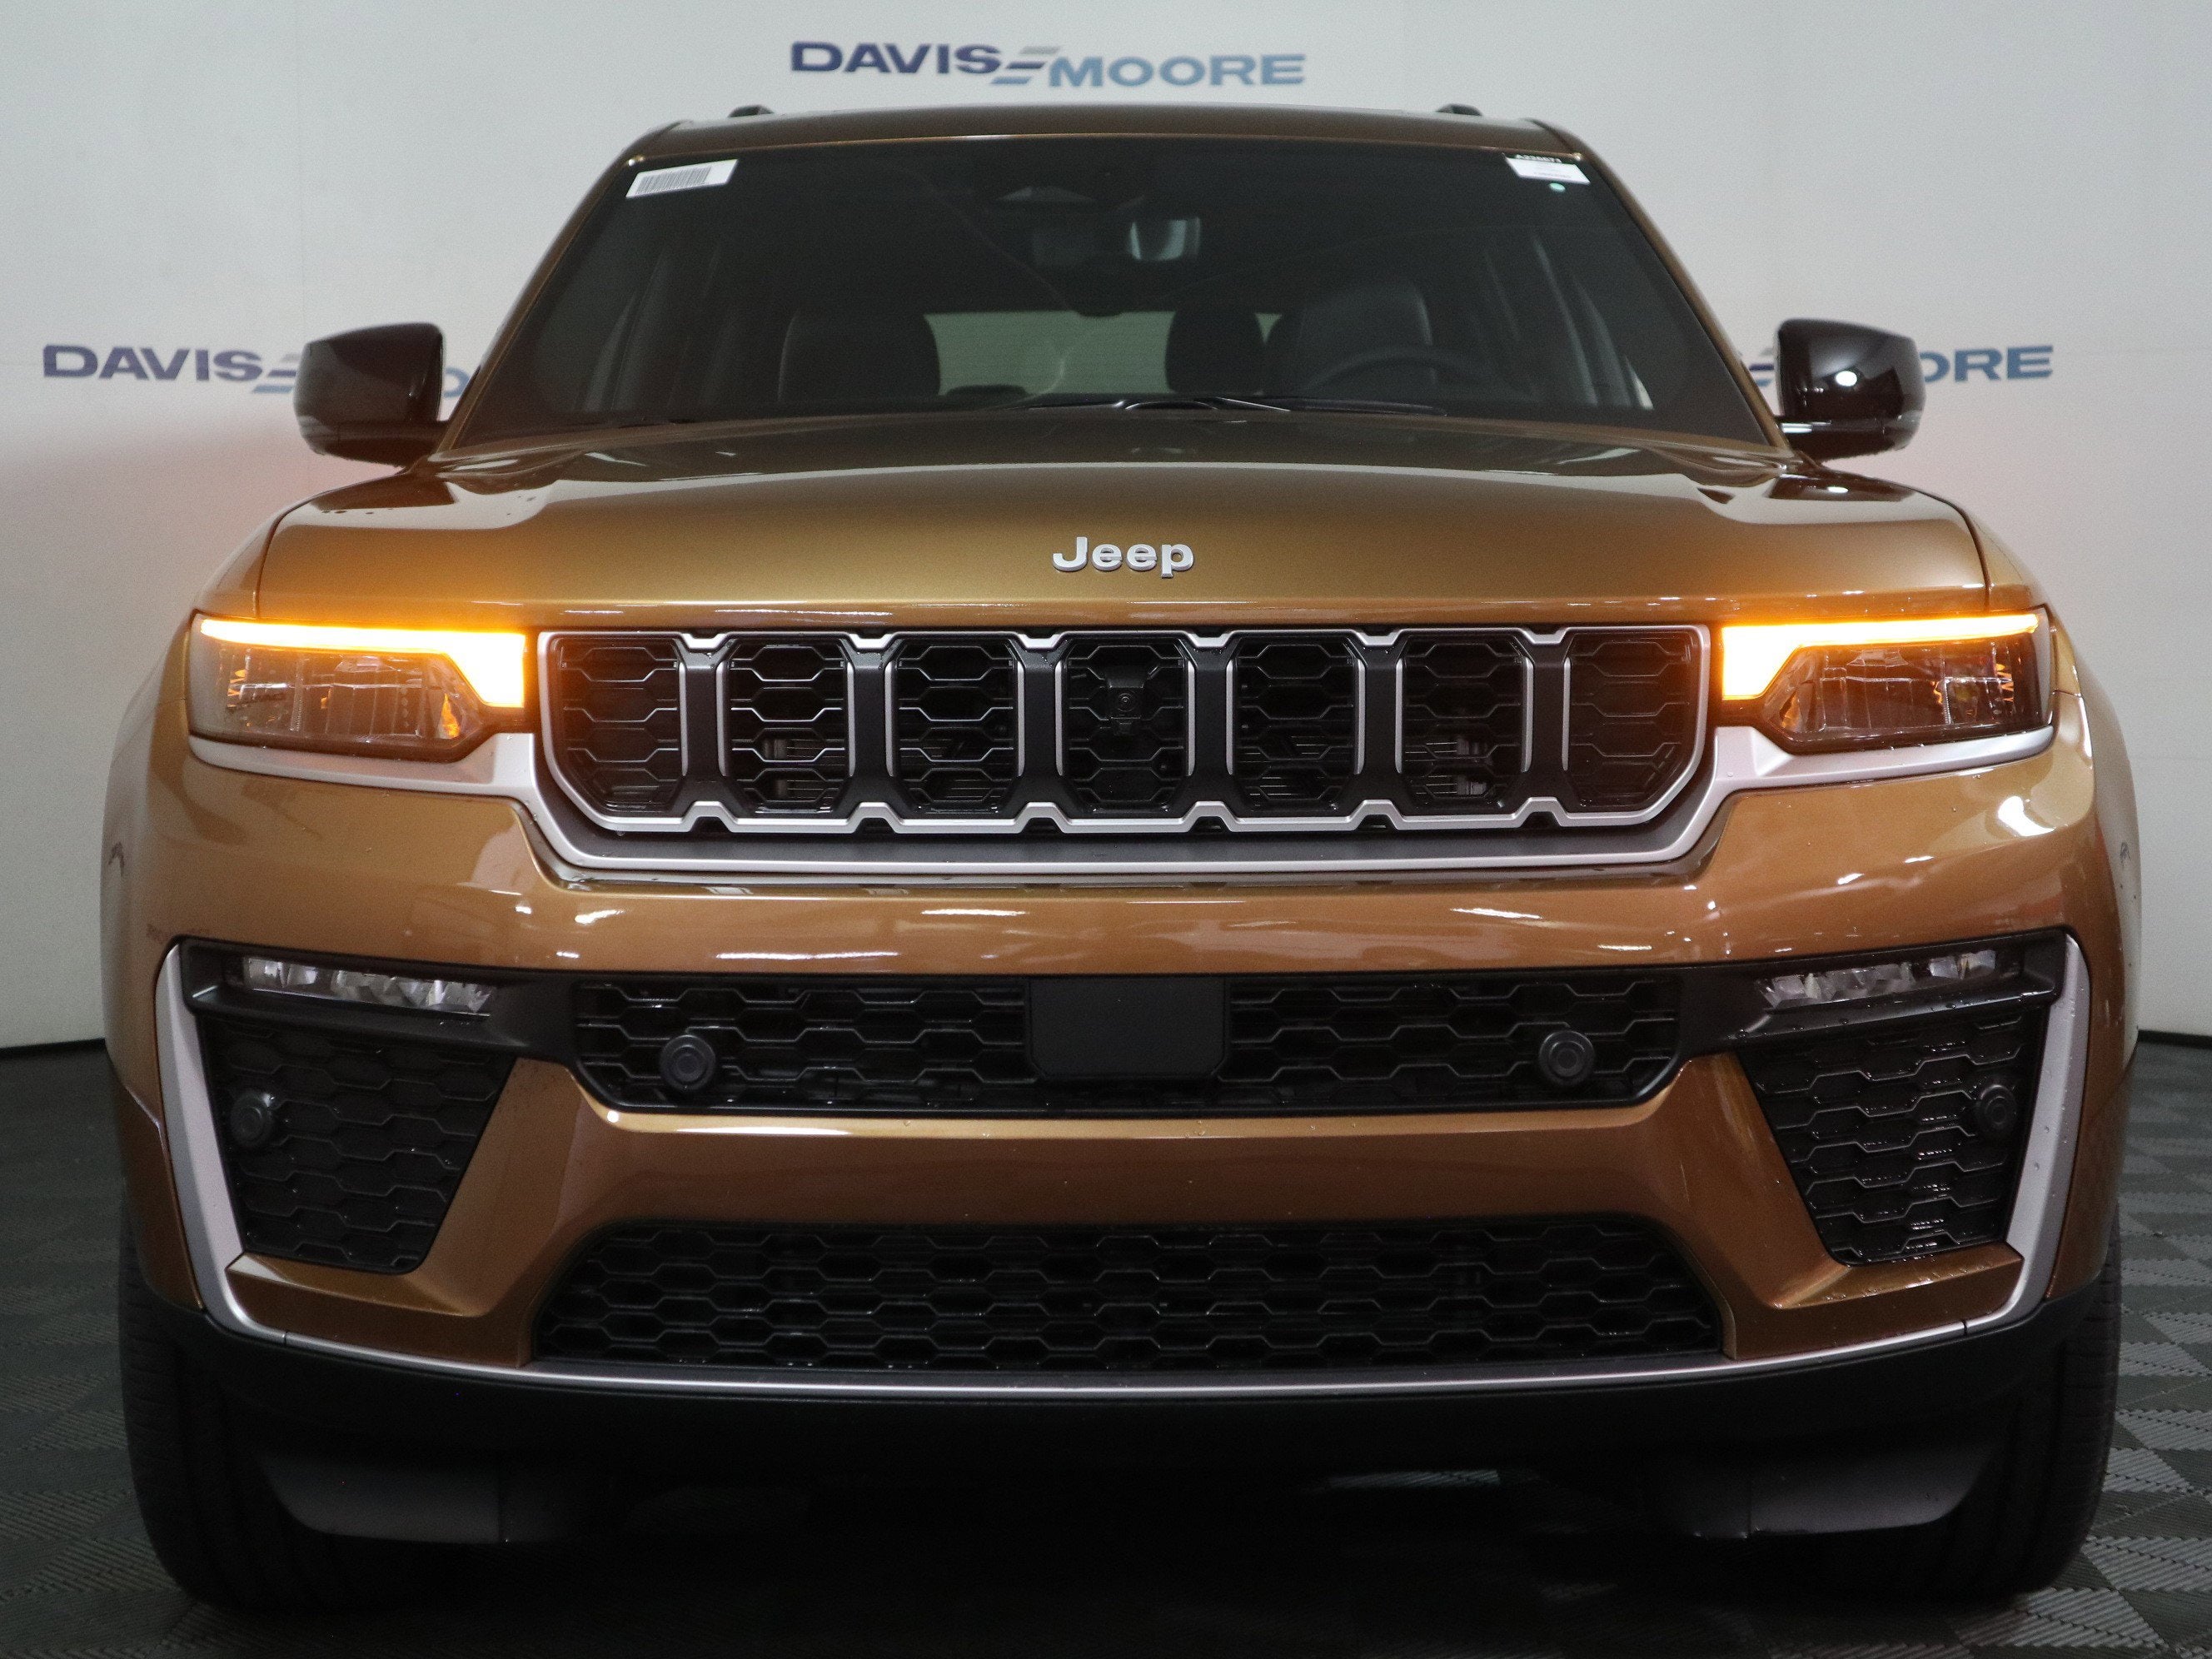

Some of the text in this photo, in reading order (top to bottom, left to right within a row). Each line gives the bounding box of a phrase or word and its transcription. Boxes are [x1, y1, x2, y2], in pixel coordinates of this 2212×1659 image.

[790, 41, 1306, 87] DAVIS MOORE
[42, 343, 263, 381] DAVIS
[1053, 536, 1195, 579] Jeep
